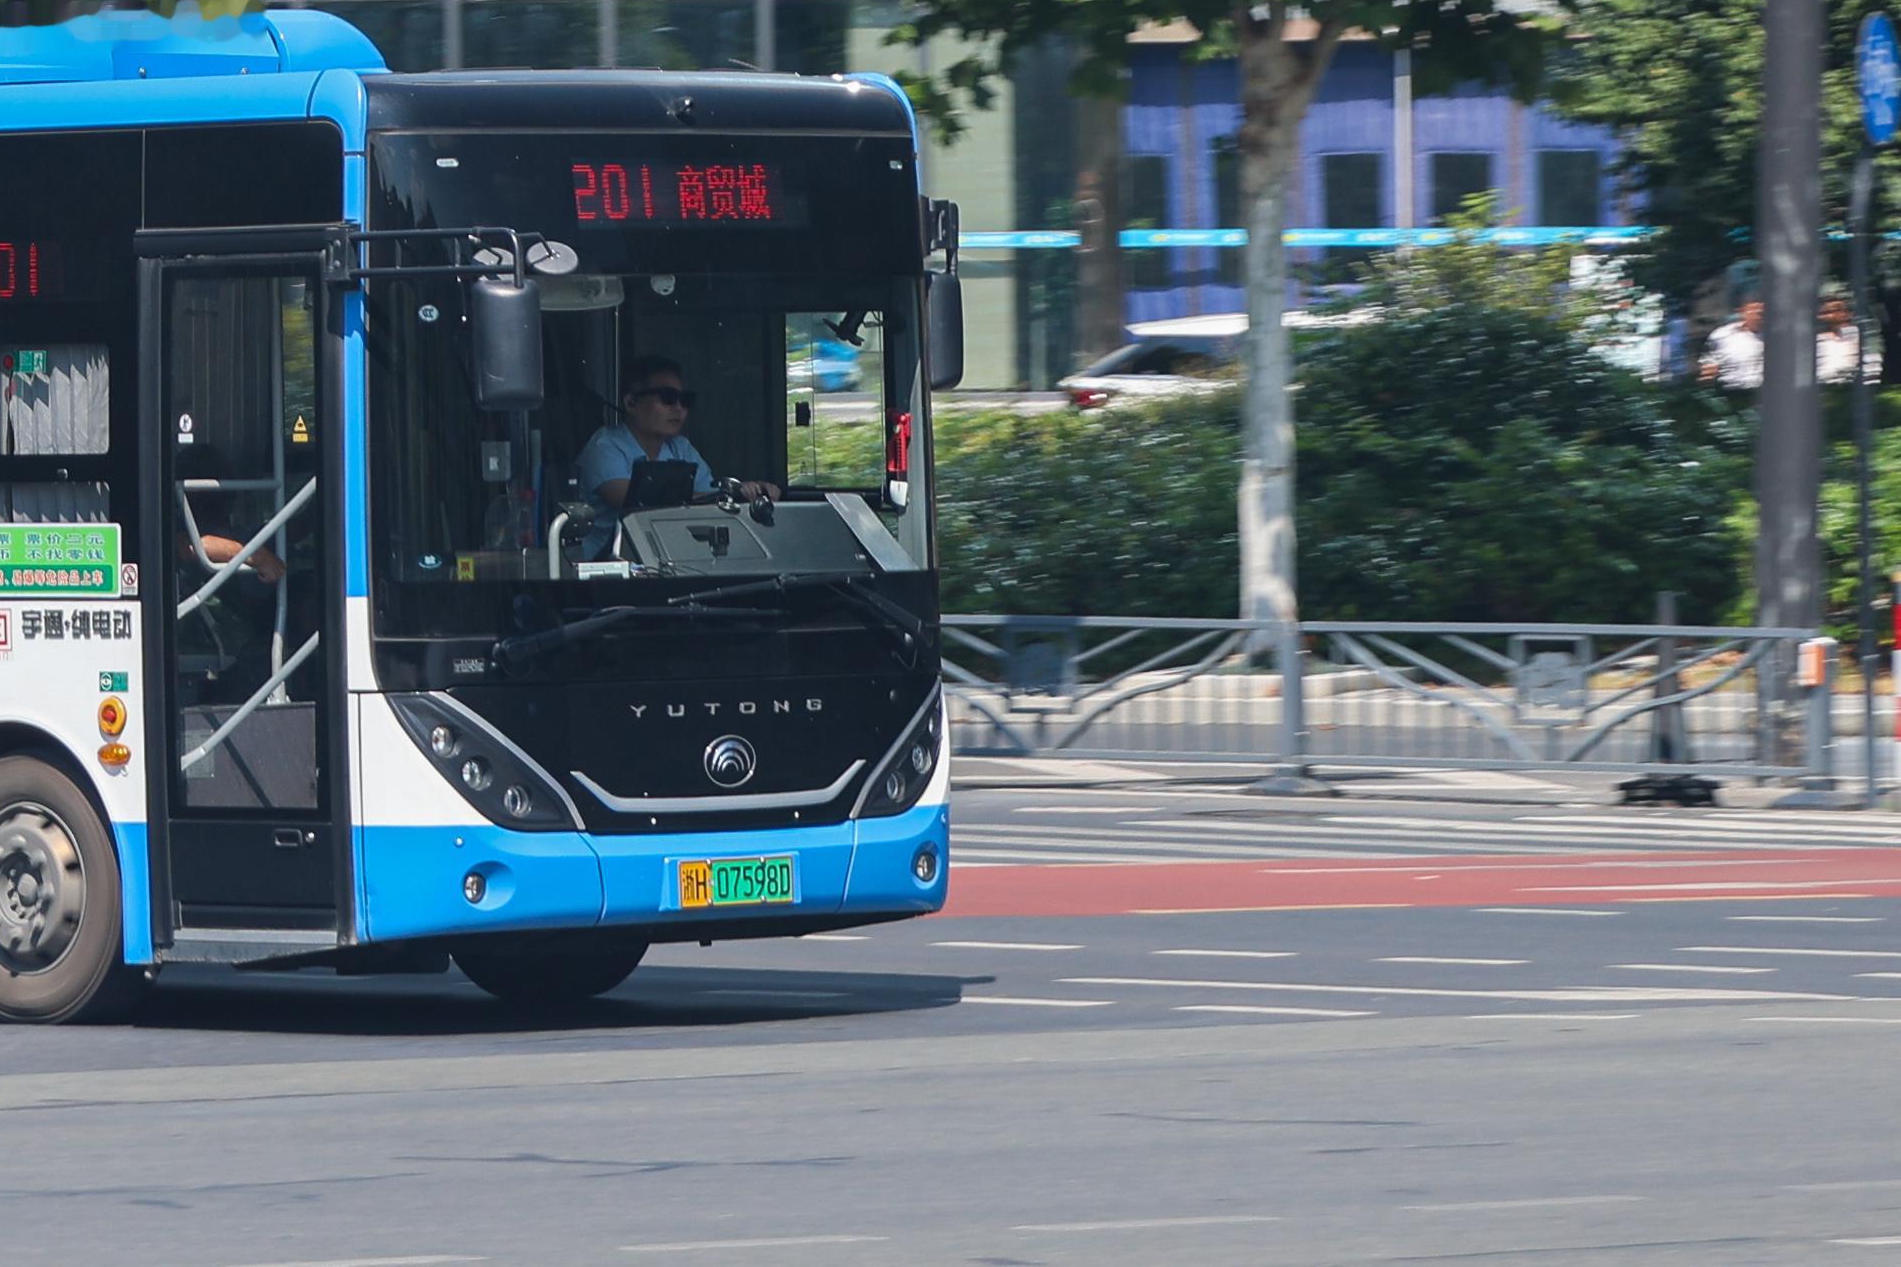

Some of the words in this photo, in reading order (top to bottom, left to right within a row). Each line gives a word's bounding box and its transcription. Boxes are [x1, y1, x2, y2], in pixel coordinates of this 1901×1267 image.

[571, 164, 652, 220] 201
[676, 164, 770, 219] 商贸城
[27, 548, 104, 560] 不找零钱
[630, 699, 823, 718] YUTONG
